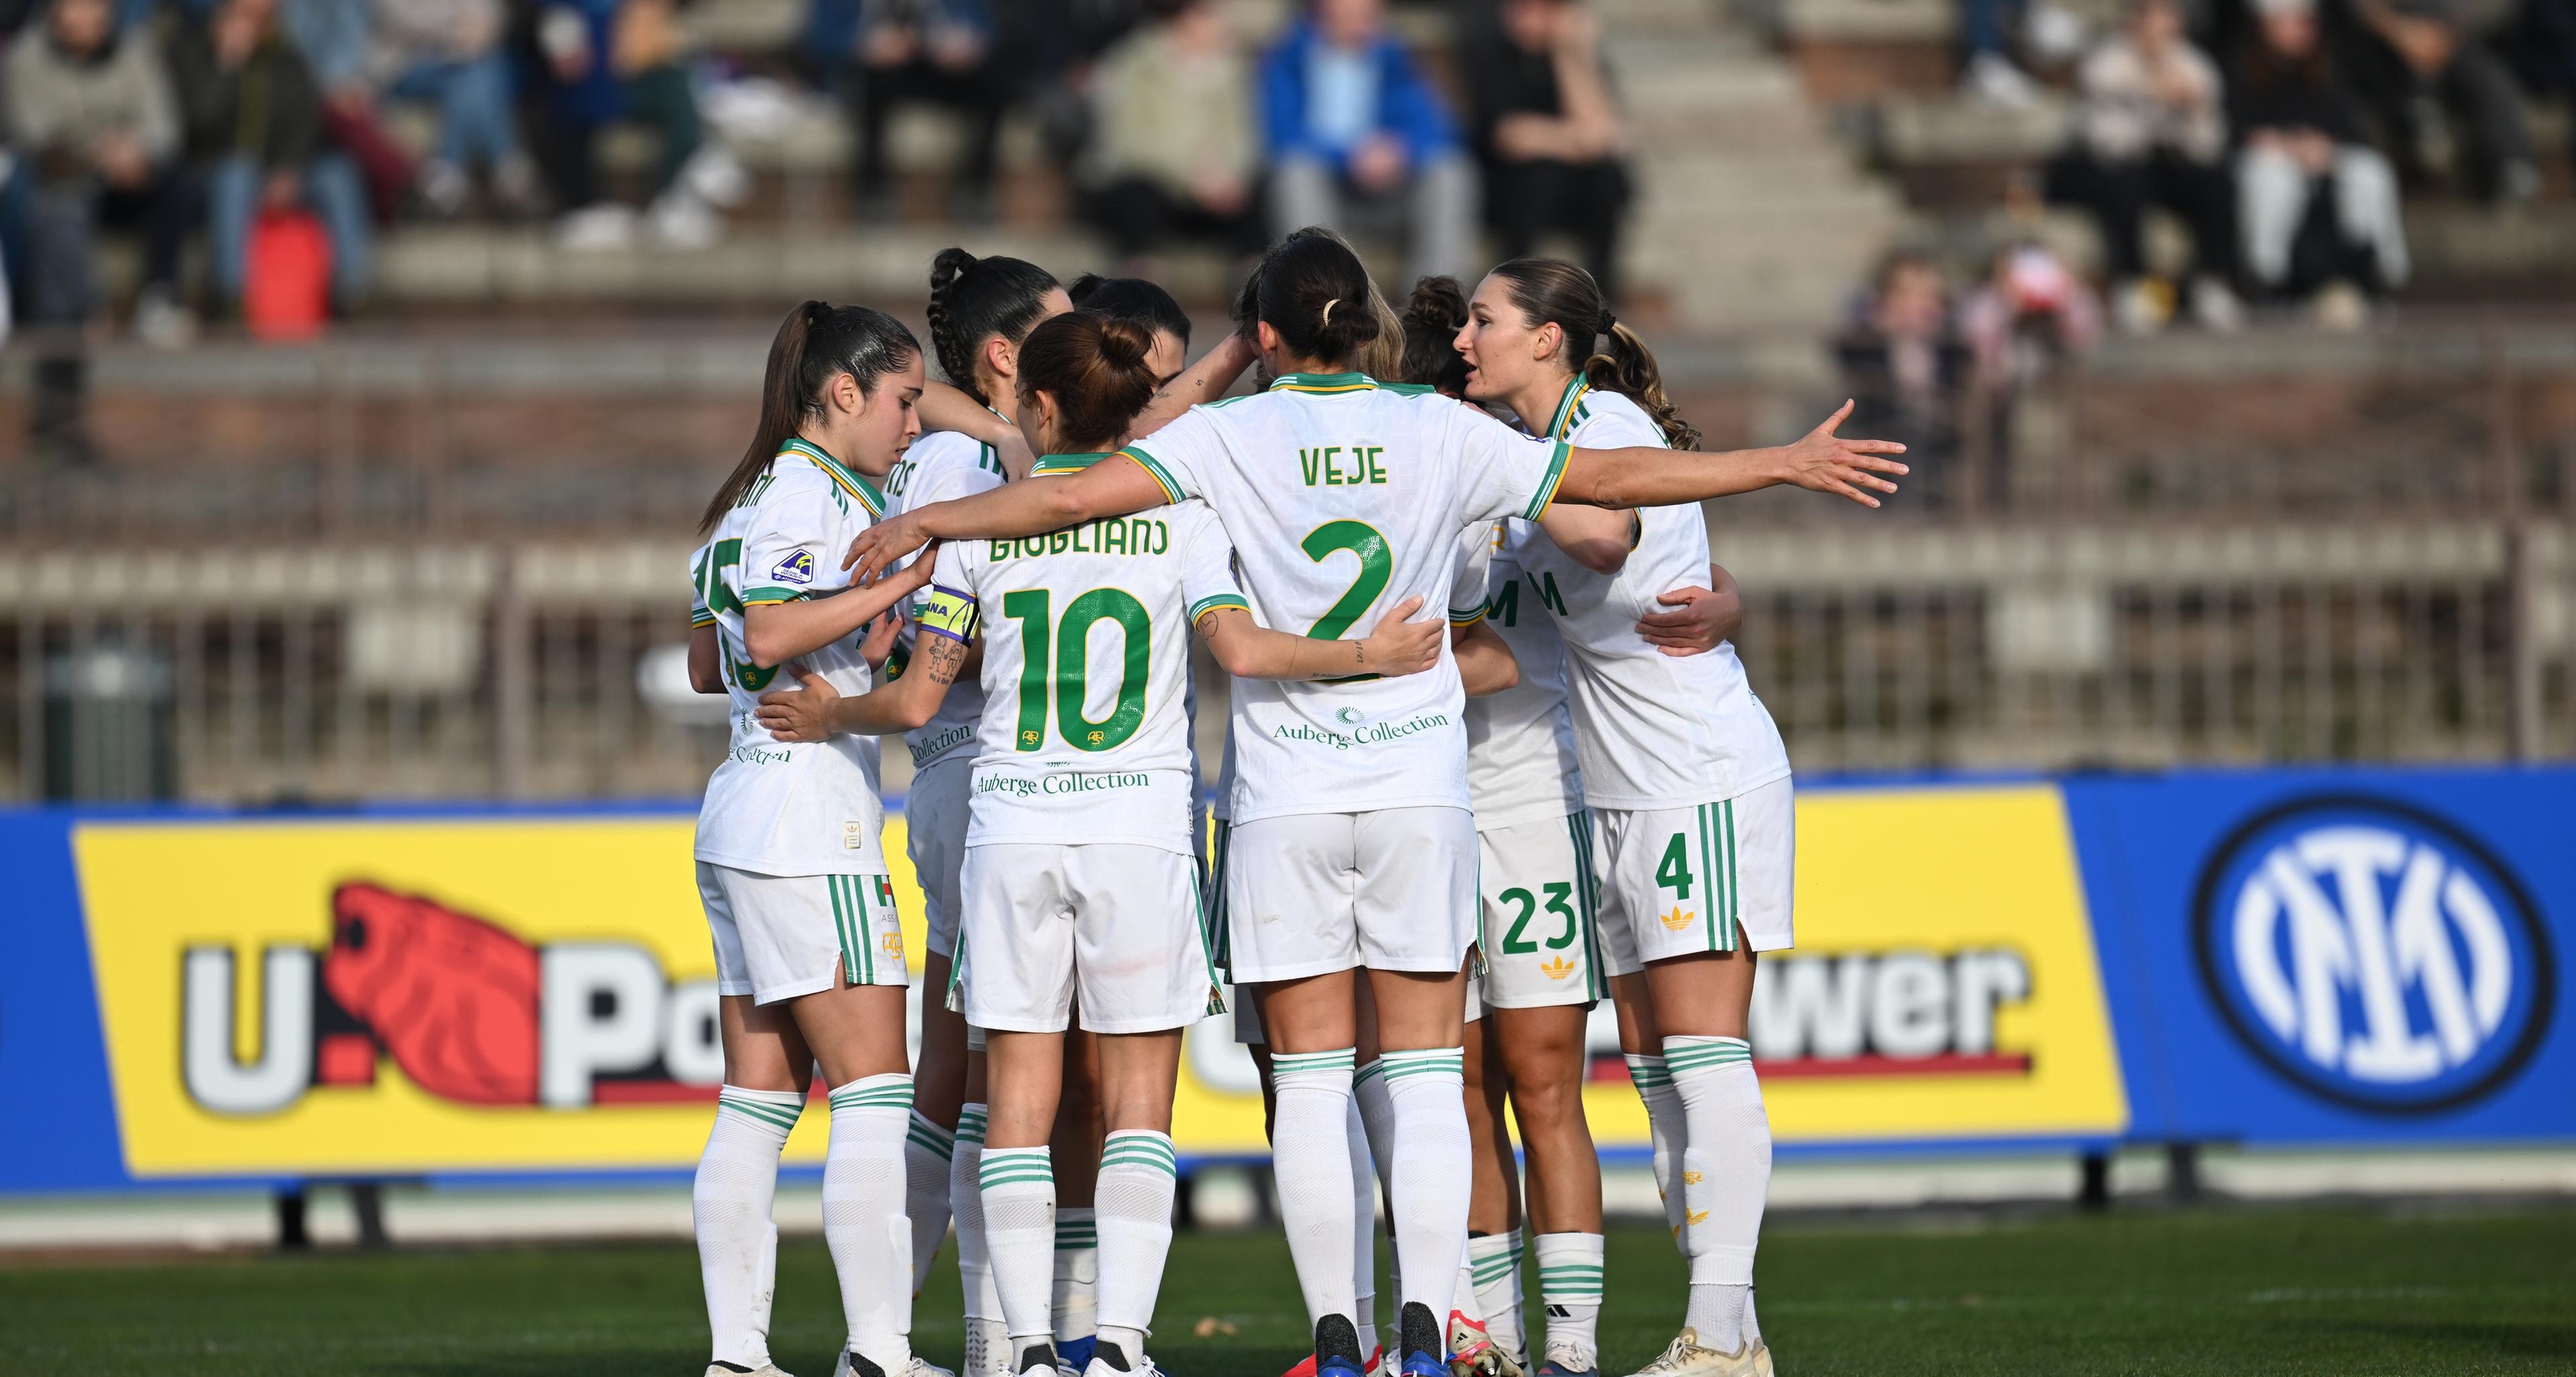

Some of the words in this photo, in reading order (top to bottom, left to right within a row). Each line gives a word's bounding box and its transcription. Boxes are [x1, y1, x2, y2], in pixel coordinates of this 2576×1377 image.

[1299, 446, 1388, 486] VEJE
[989, 518, 1169, 562] GIUGLIANO
[1301, 519, 1393, 683] 2
[1004, 588, 1151, 751] 10
[909, 725, 971, 762] Collection
[1273, 724, 1354, 750] Auberge
[1354, 714, 1449, 745] Collection
[976, 773, 1038, 797] Auberge
[1042, 771, 1149, 794] Collection
[1655, 832, 1693, 900] 4
[1499, 882, 1576, 954] 23
